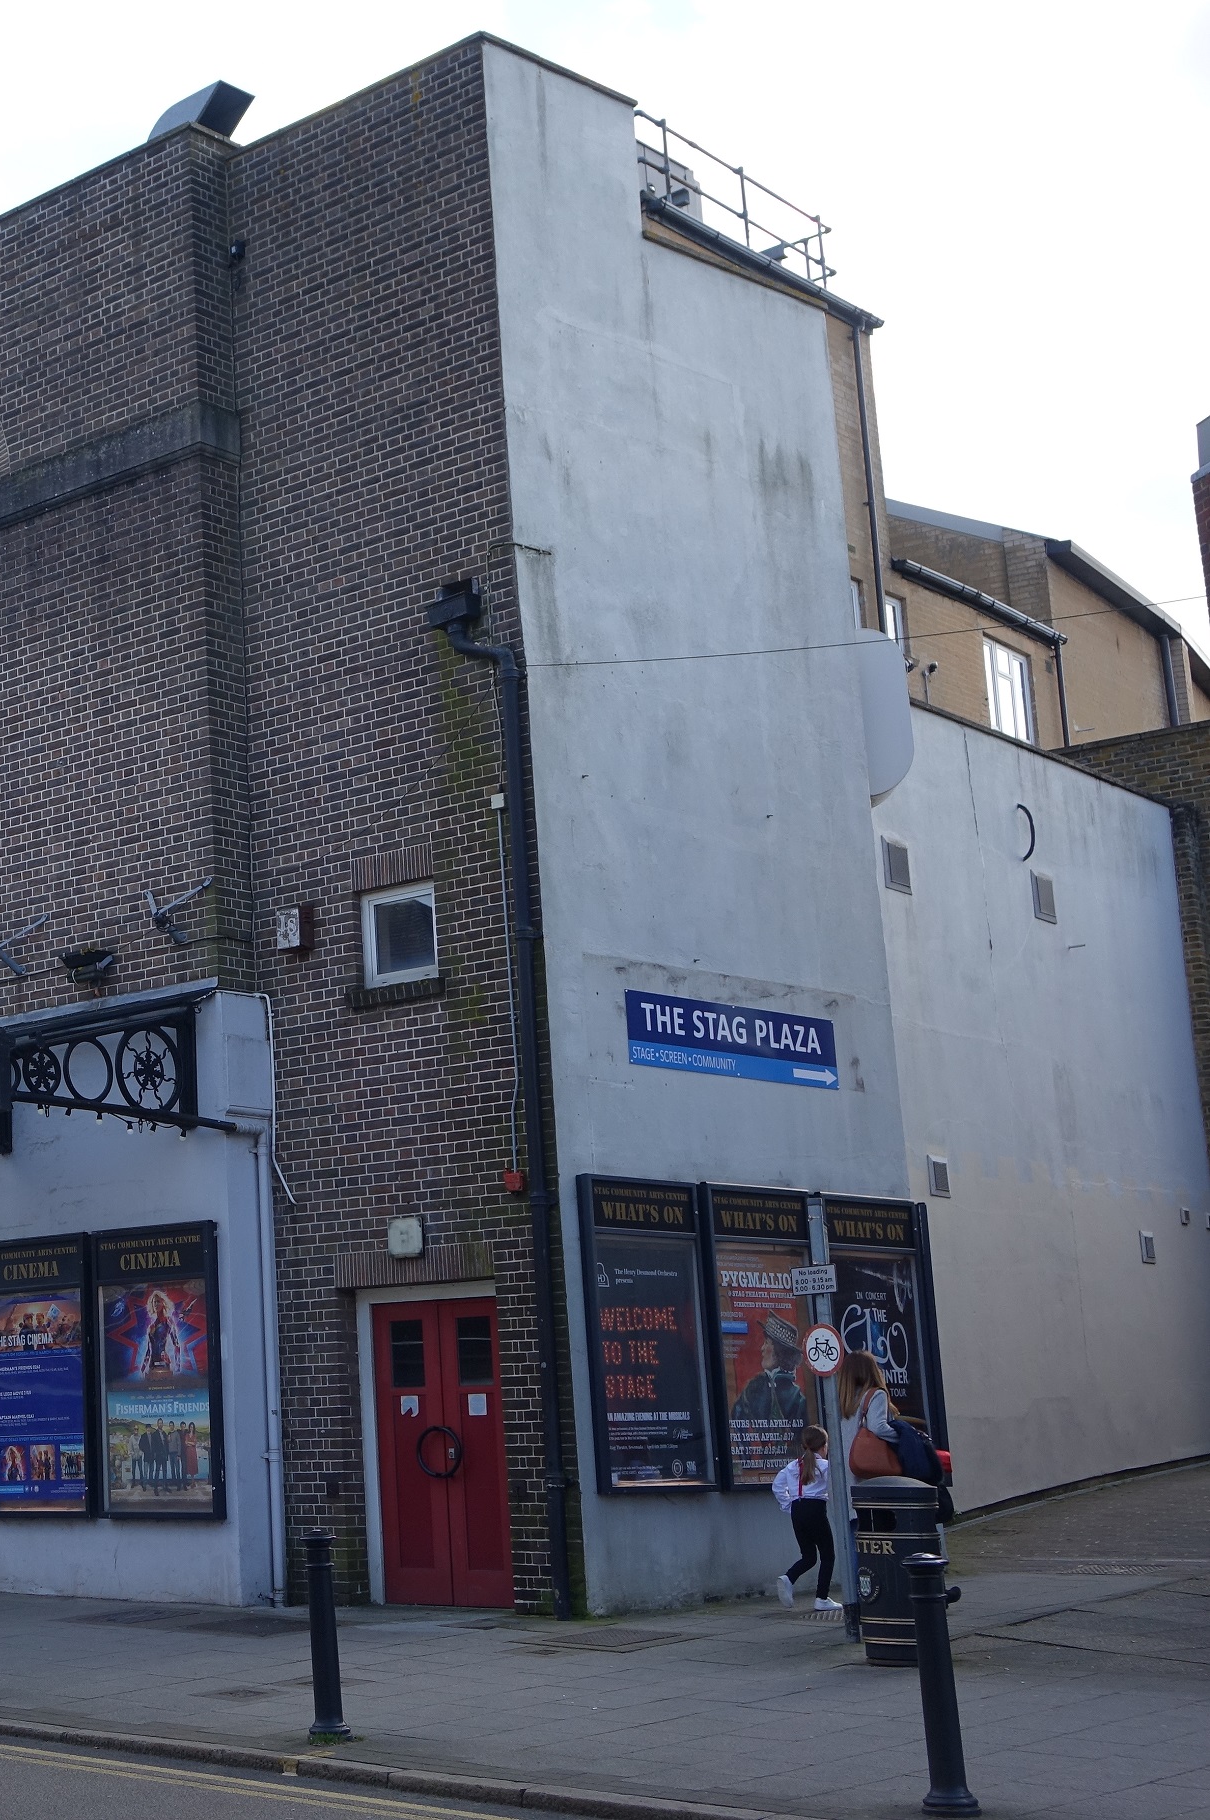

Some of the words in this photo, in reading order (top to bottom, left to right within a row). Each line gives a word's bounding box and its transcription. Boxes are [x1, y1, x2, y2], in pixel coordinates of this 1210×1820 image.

[640, 1002, 686, 1036] THE
[692, 1010, 747, 1044] STAG
[754, 1019, 822, 1055] PLAZA
[594, 1187, 610, 1195] STAG
[611, 1188, 647, 1198] COMMUNITY
[649, 1191, 664, 1199] ARTS
[665, 1193, 688, 1201] CENTRE
[730, 1197, 763, 1207] COMMUNITY
[764, 1200, 779, 1209] ARTS
[780, 1201, 801, 1210] CENTRE
[601, 1201, 659, 1223] WHAT'S
[663, 1205, 683, 1225] ON
[720, 1210, 775, 1231] WHAT'S
[778, 1214, 797, 1232] ON
[833, 1220, 884, 1239] WHAT'S
[887, 1224, 904, 1241] ON
[100, 1242, 116, 1251] STAG
[117, 1238, 156, 1250] COMMUNITY
[157, 1237, 174, 1246] ARTS
[175, 1235, 201, 1244] CENTRE
[1, 1250, 36, 1260] COMMUNITY
[38, 1248, 53, 1257] ARTS
[53, 1246, 78, 1255] CENTRE
[119, 1250, 181, 1271] CINEMA
[3, 1260, 60, 1281] CINEMA
[624, 1268, 636, 1277] Henry
[721, 1270, 793, 1290] PYGMALIO
[795, 1278, 809, 1286] 8.00
[855, 1291, 863, 1300] IN
[865, 1291, 887, 1300] CONCERT
[600, 1306, 678, 1331] WELCOME
[871, 1308, 888, 1323] THE
[8, 1334, 26, 1347] STAG
[27, 1332, 54, 1346] CINEMA
[840, 1303, 909, 1371] ELO
[601, 1340, 623, 1365] TO
[628, 1339, 660, 1365] THE
[604, 1374, 657, 1400] STAGE
[890, 1387, 907, 1397] TOUR
[115, 1402, 173, 1416] FISHERMAN'S
[173, 1401, 210, 1414] FRIENDS
[614, 1412, 635, 1421] AMAZING
[635, 1412, 653, 1421] EVENING
[653, 1412, 659, 1420] AT
[659, 1411, 668, 1420] THE
[668, 1411, 690, 1420] MUSICALS
[750, 1419, 769, 1428] 11TH
[769, 1419, 791, 1428] APRIL:
[792, 1419, 804, 1428] £15
[742, 1432, 761, 1441] 12TH
[761, 1432, 783, 1441] APRIL:
[783, 1432, 794, 1441] £17
[731, 1446, 745, 1455] SAT
